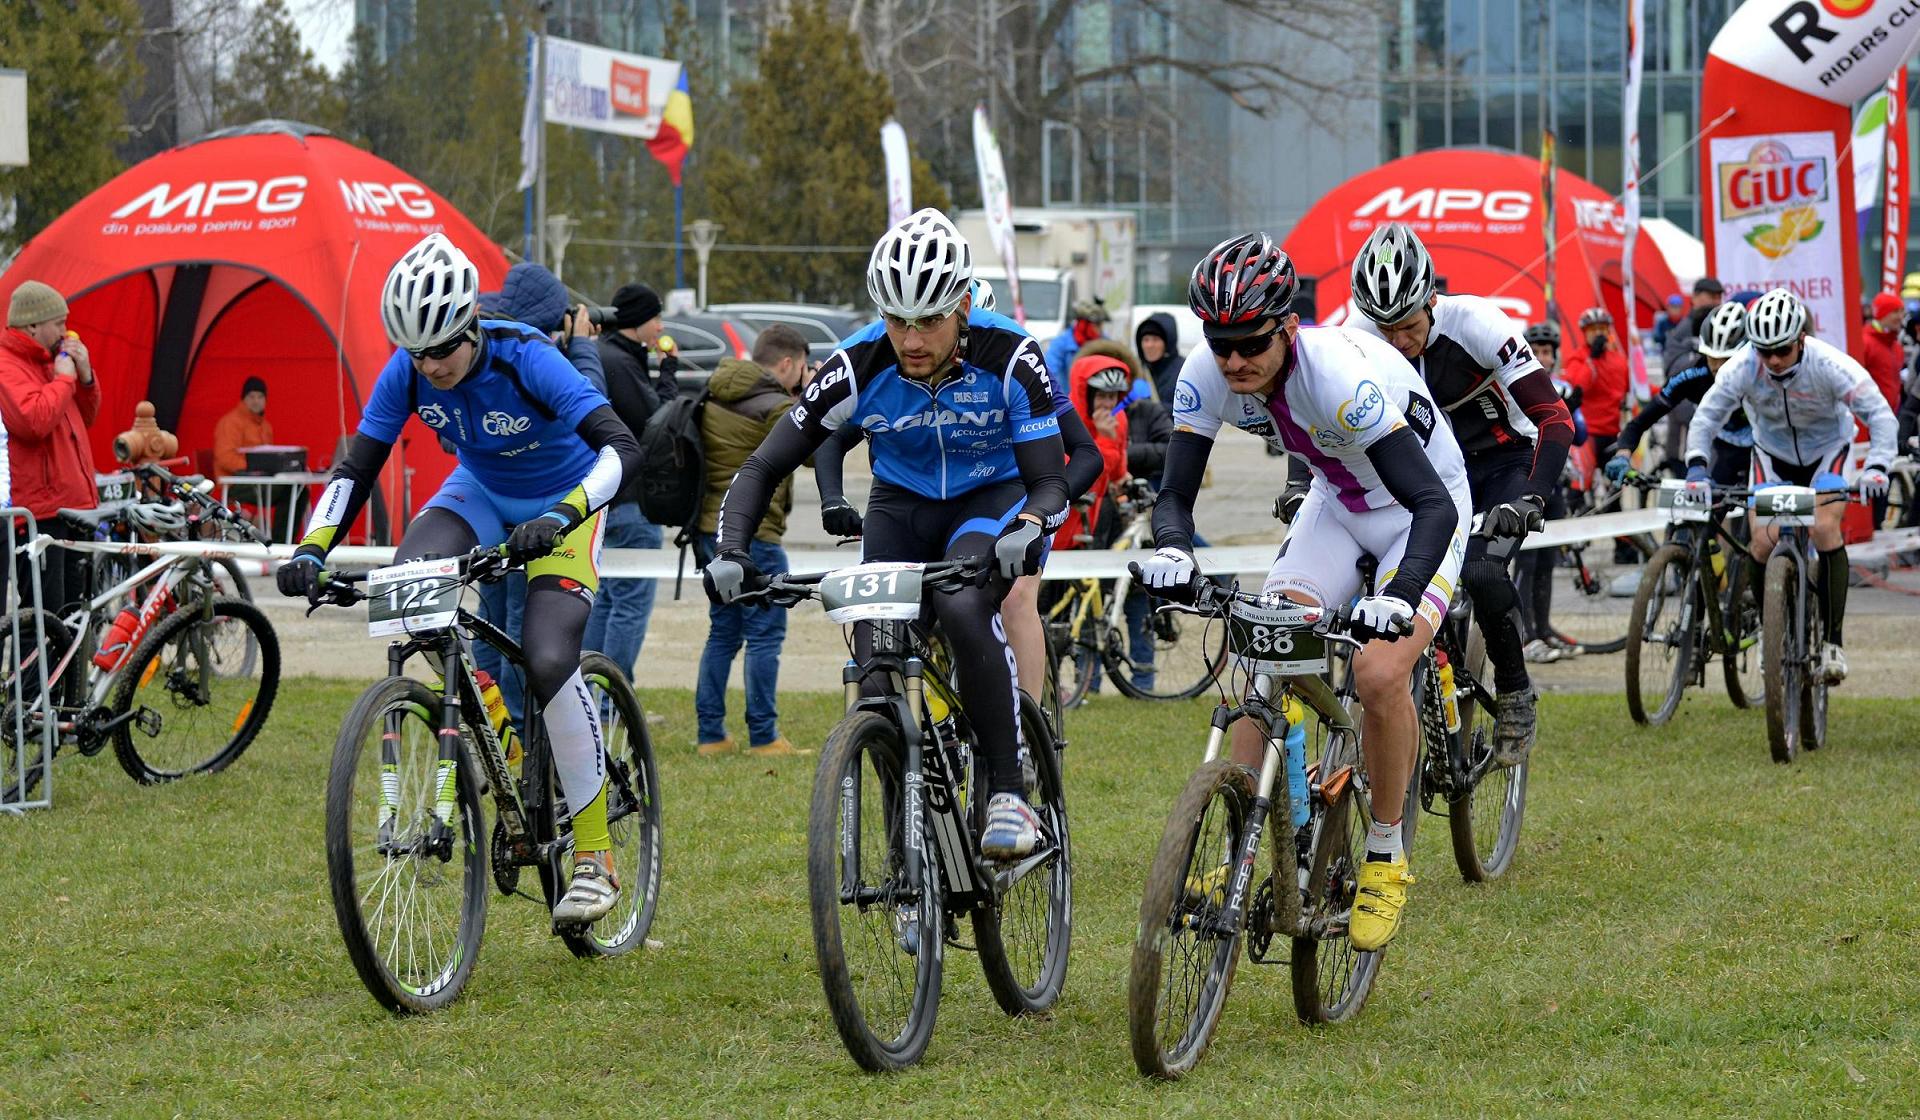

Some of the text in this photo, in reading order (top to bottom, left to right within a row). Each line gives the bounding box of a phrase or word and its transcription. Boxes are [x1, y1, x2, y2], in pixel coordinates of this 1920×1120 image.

[1818, 0, 1920, 88] RIDERS CL
[110, 176, 307, 219] MPG
[339, 178, 435, 219] MPG
[1353, 187, 1533, 221] MPG
[102, 216, 297, 236] din pasiune pentru sport
[1436, 222, 1482, 234] pentru
[1487, 223, 1526, 234] sport
[893, 409, 1006, 433] GIANT
[1345, 387, 1381, 427] Becel
[1477, 396, 1499, 420] PRO
[104, 483, 123, 499] 48
[325, 484, 342, 521] MERIDA
[1772, 494, 1797, 511] 54
[384, 578, 440, 611] 122
[840, 571, 899, 599] 131
[1244, 611, 1264, 621] URBAN
[1252, 625, 1294, 654] 88
[575, 684, 603, 777] MERIDA
